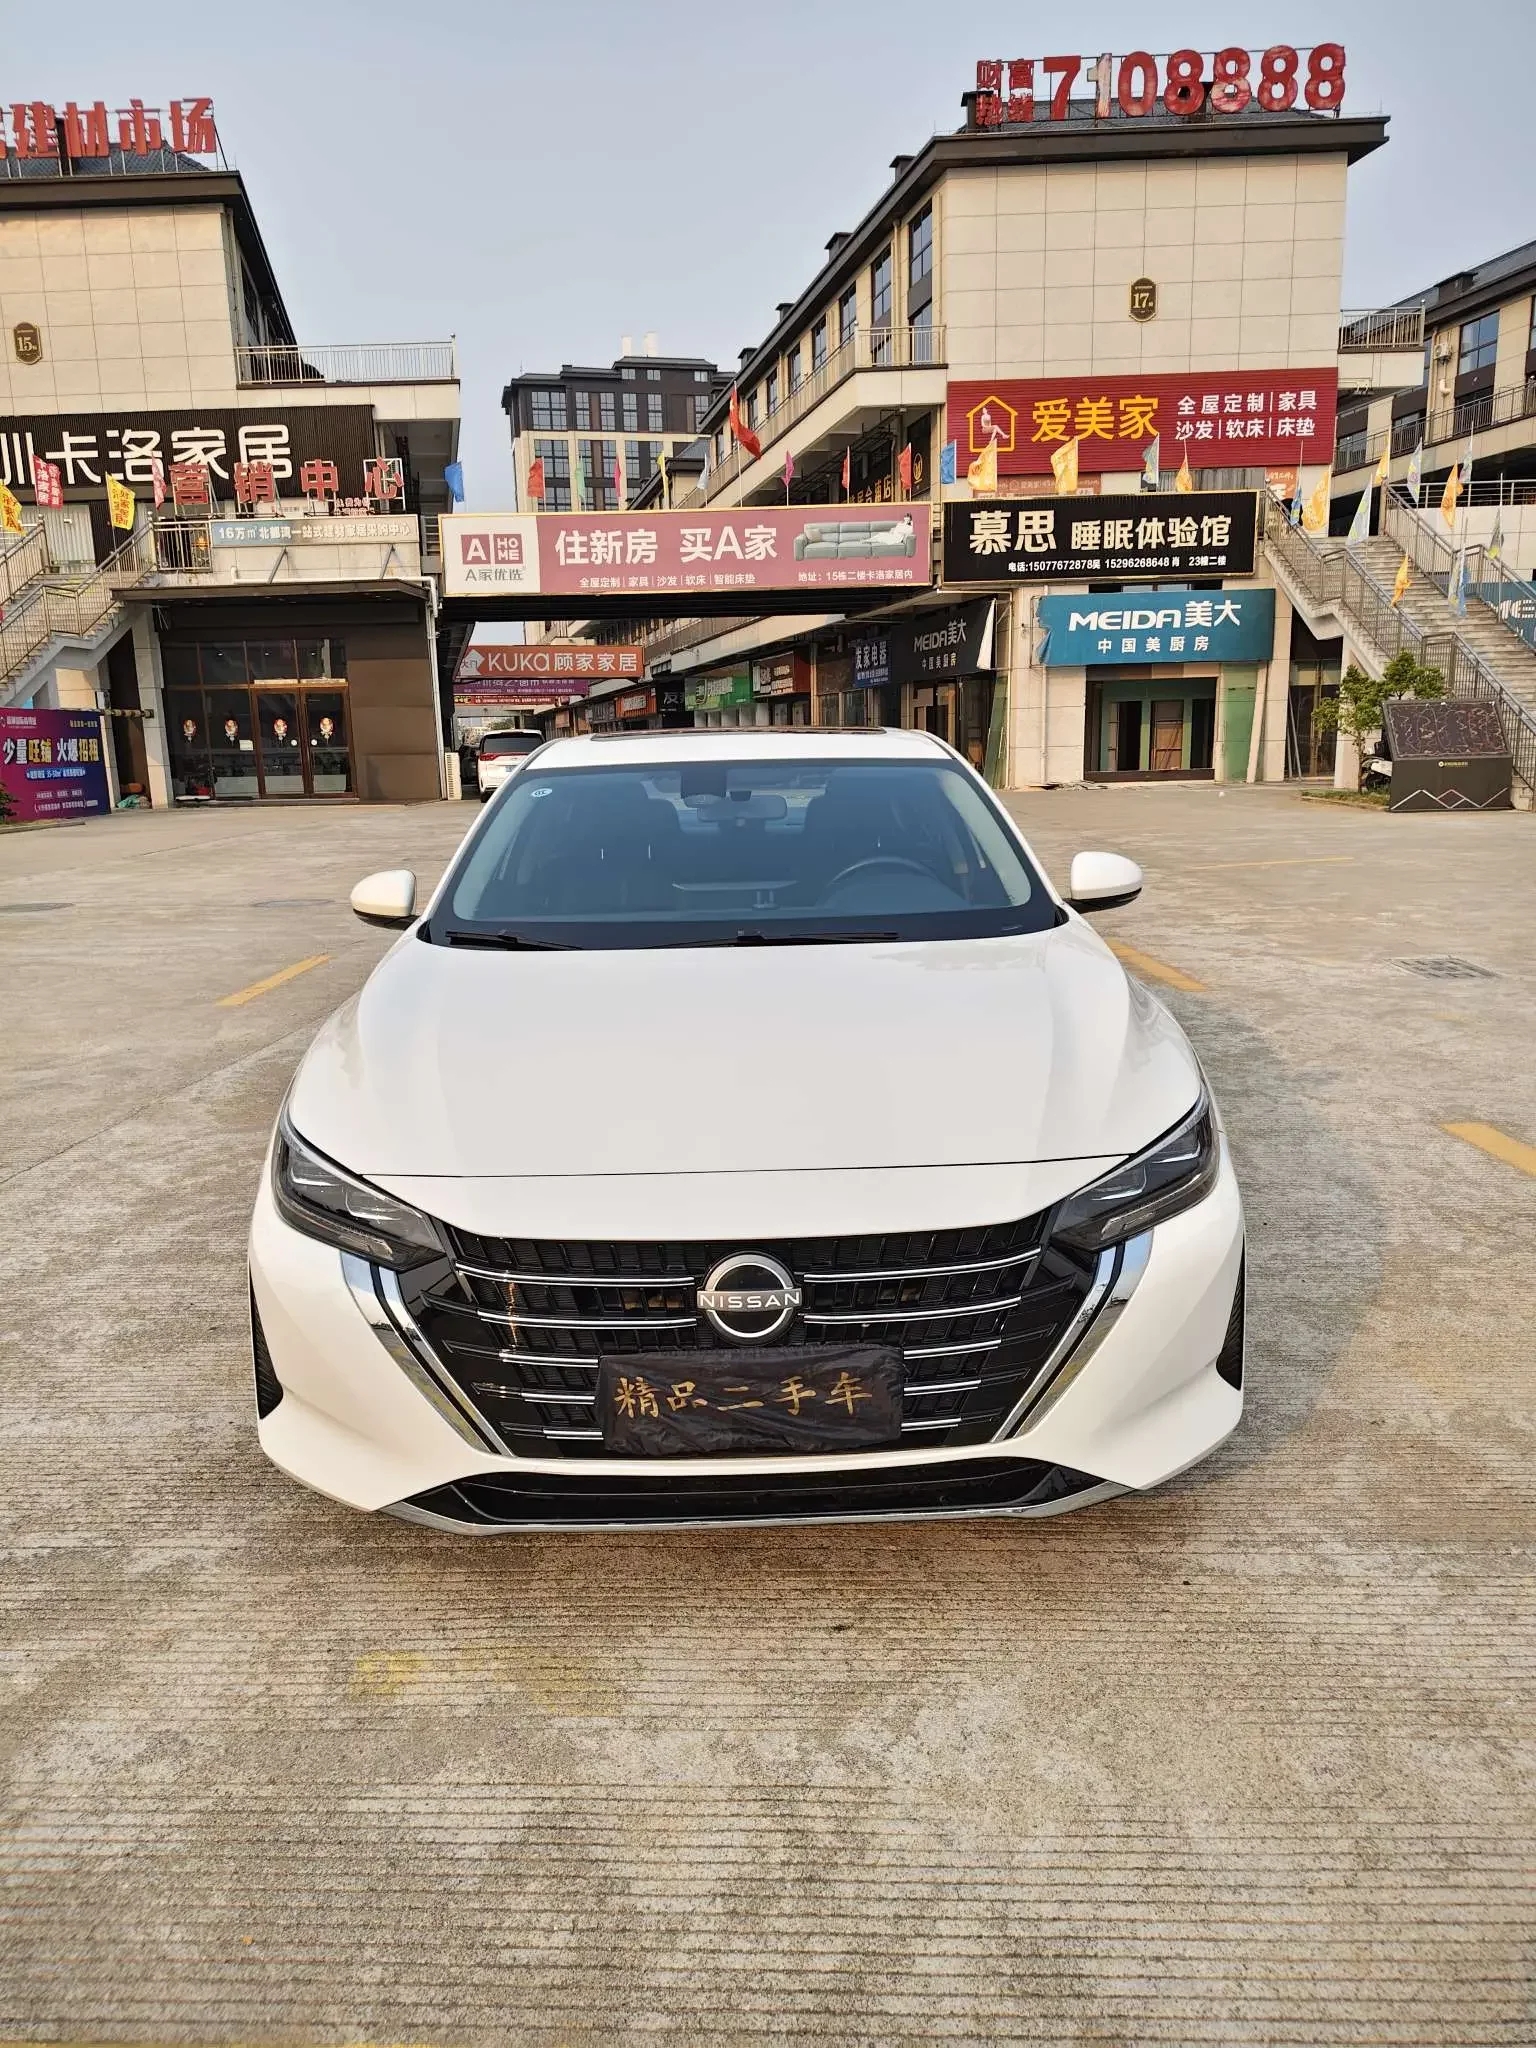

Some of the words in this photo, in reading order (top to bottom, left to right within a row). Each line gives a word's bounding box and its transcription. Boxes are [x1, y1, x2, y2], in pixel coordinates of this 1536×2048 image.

[1043, 42, 1346, 121] 7108888
[1177, 394, 1263, 416] 全屋定制
[1278, 390, 1317, 412] 家具
[1031, 395, 1159, 443] 爱美家
[1175, 419, 1214, 441] 沙发
[1225, 418, 1265, 439] 软床
[1276, 416, 1316, 438] 床垫
[168, 456, 405, 506] 营销中心
[555, 528, 659, 566] 住新房
[679, 525, 778, 563] 买A家
[969, 510, 1057, 555] 慕思
[1071, 514, 1232, 551] 睡眠体验馆
[466, 537, 487, 561] A
[579, 576, 621, 588] 全屋定制
[628, 575, 649, 587] 家具
[656, 575, 678, 587] 沙发
[685, 574, 706, 586] 软床
[714, 573, 756, 585] 智能床垫
[1098, 636, 1209, 654] 中国美厨房
[3, 738, 52, 765] 少量旺铺
[57, 738, 99, 762] 火爆招租
[699, 1290, 800, 1309] NISSAN
[614, 1372, 872, 1418] 精品二手车
